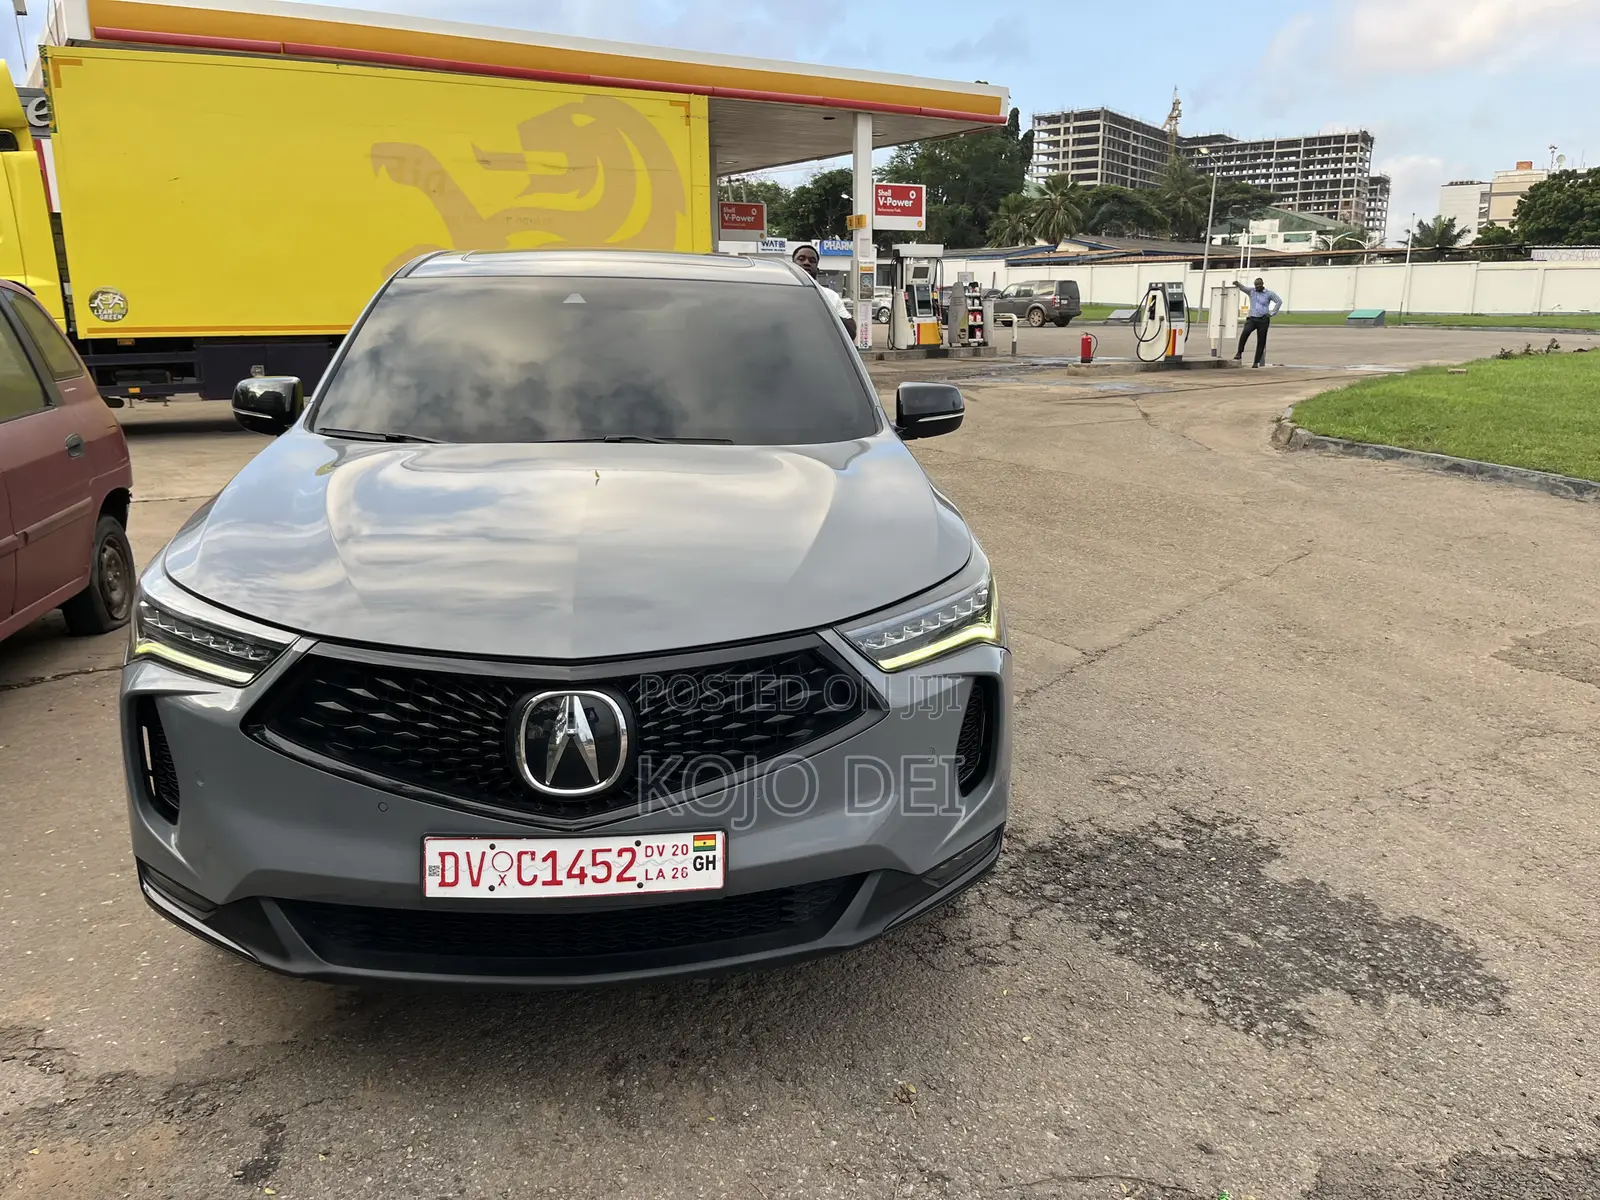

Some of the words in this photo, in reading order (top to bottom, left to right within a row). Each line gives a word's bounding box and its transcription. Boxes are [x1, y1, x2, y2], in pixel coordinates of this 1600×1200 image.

[877, 189, 892, 197] Shell
[877, 197, 913, 207] V-Power
[723, 213, 756, 223] V-Power
[645, 844, 666, 858] DV
[672, 843, 689, 857] 20
[438, 850, 487, 887] DV
[516, 847, 637, 887] C1452
[692, 855, 717, 871] GH
[645, 868, 666, 881] LA
[672, 867, 689, 879] 26
